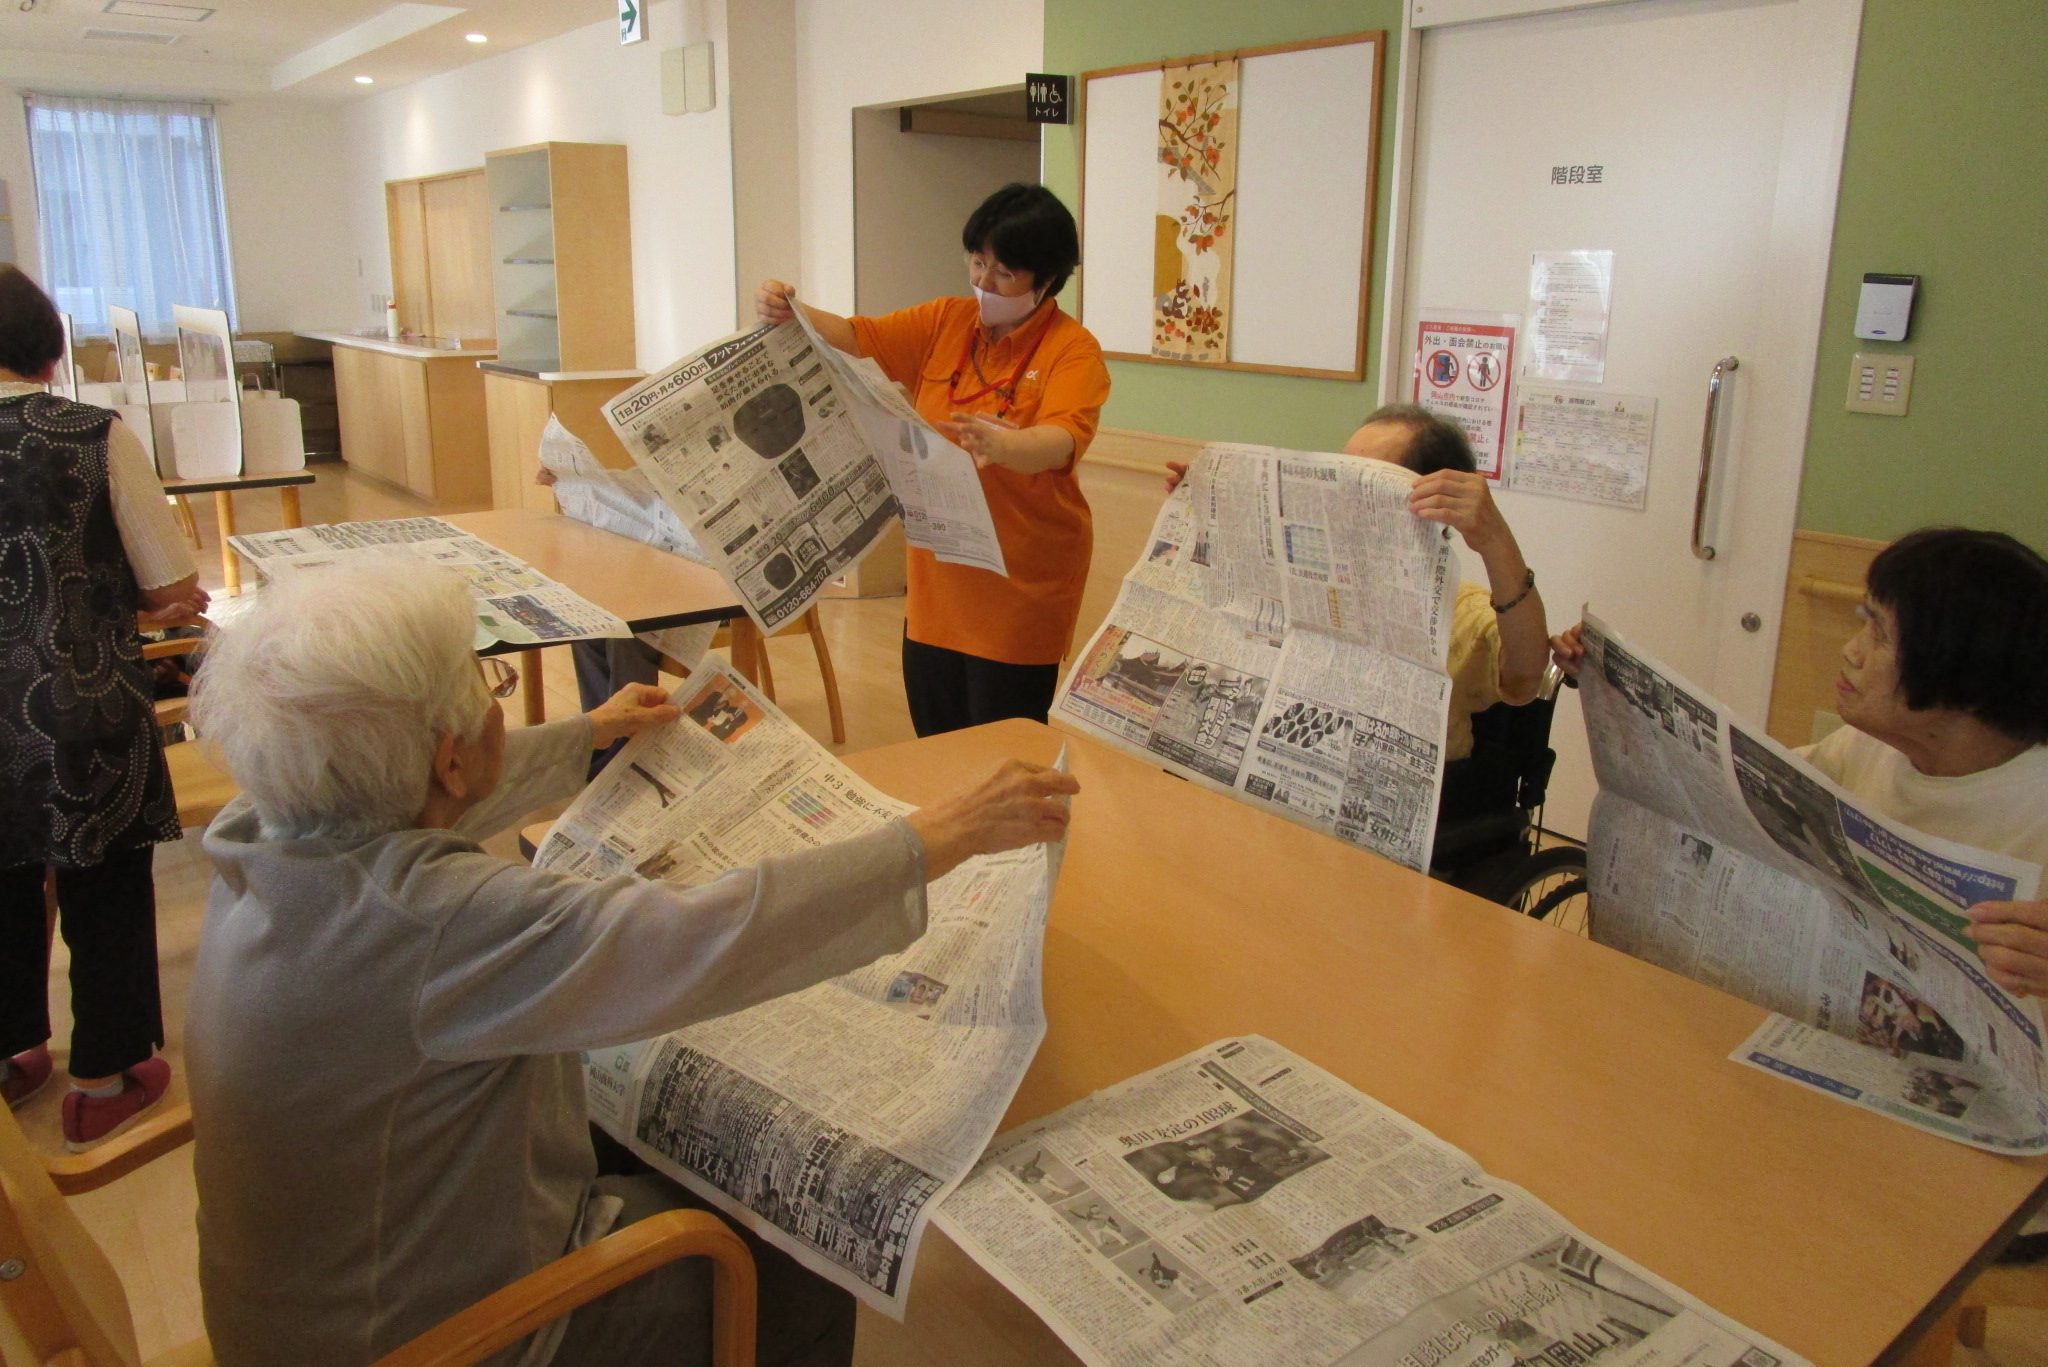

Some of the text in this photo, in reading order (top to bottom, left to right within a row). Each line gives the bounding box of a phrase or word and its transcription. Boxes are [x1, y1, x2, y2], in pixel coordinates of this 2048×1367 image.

[1035, 106, 1059, 117] トイレ
[1551, 165, 1604, 185] 階段室
